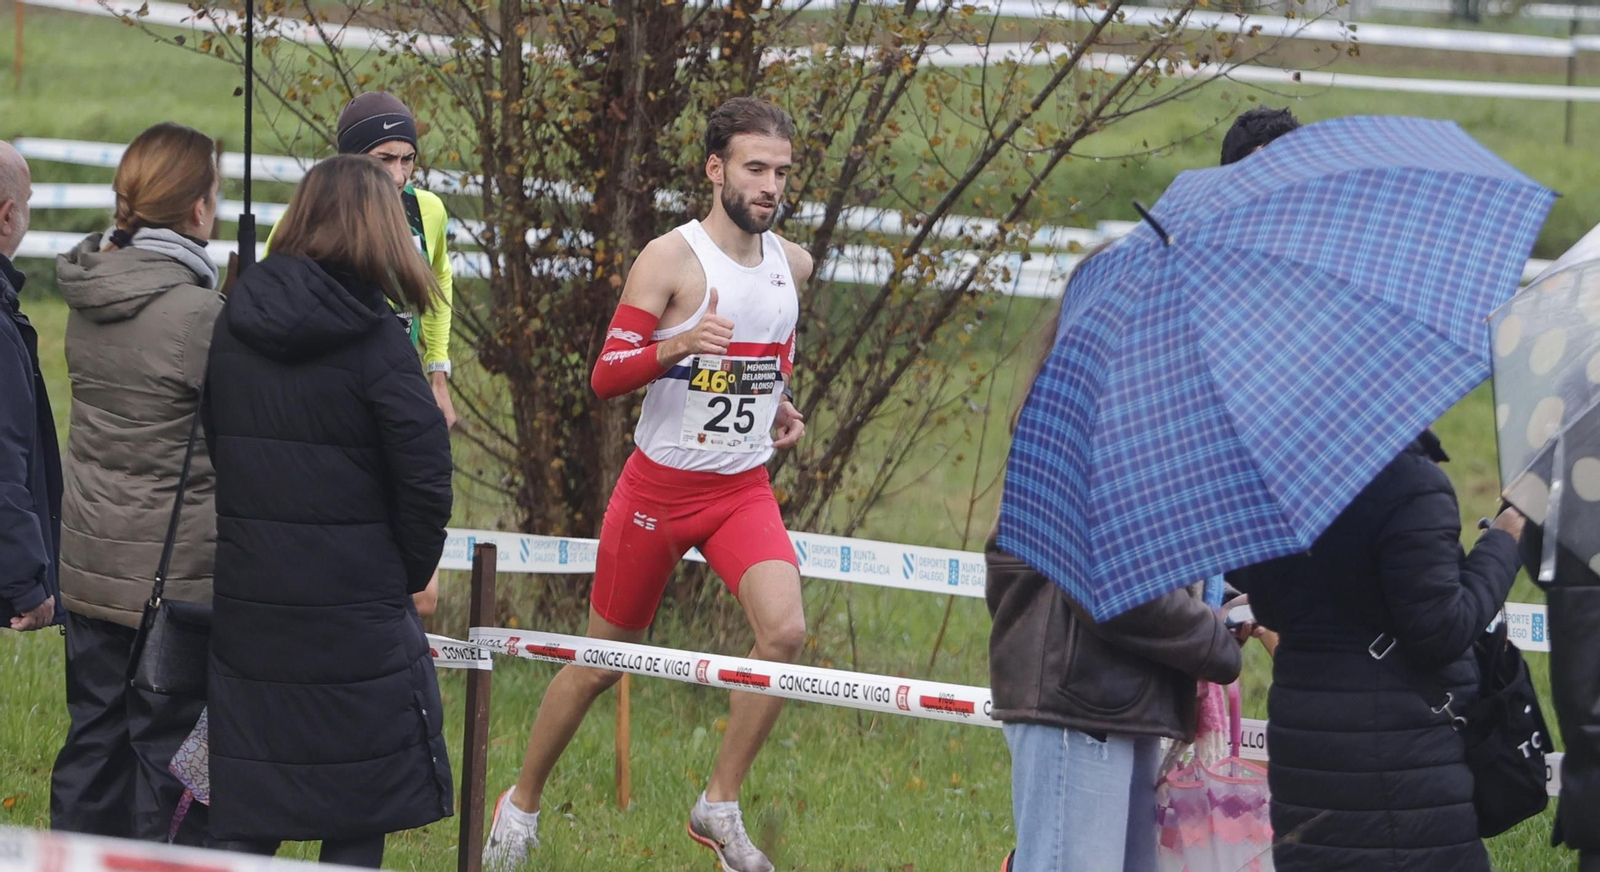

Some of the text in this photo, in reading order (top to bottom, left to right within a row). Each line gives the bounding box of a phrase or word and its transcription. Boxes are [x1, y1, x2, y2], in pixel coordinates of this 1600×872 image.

[746, 363, 777, 372] MEMORIAL
[741, 372, 776, 381] BELARMINO
[750, 381, 774, 390] ALONSO
[703, 396, 756, 434] 25
[445, 537, 466, 547] EPORTE
[533, 540, 558, 550] DEPORTE
[811, 544, 839, 557] DEPORTE
[853, 550, 876, 561] XUNTA
[533, 552, 556, 563] GALEGO
[570, 552, 578, 562] DE
[812, 557, 837, 569] GALEGO
[852, 562, 890, 575] DE GALICIA
[918, 556, 947, 570] DEPORTE
[961, 563, 985, 574] XUNTA
[918, 571, 944, 582] GALEGO
[960, 575, 969, 585] DE
[583, 649, 642, 670] CONCELLO
[645, 656, 661, 673] DE
[663, 658, 691, 677] VIGO
[778, 674, 890, 703] CONCELLO DE VIGO
